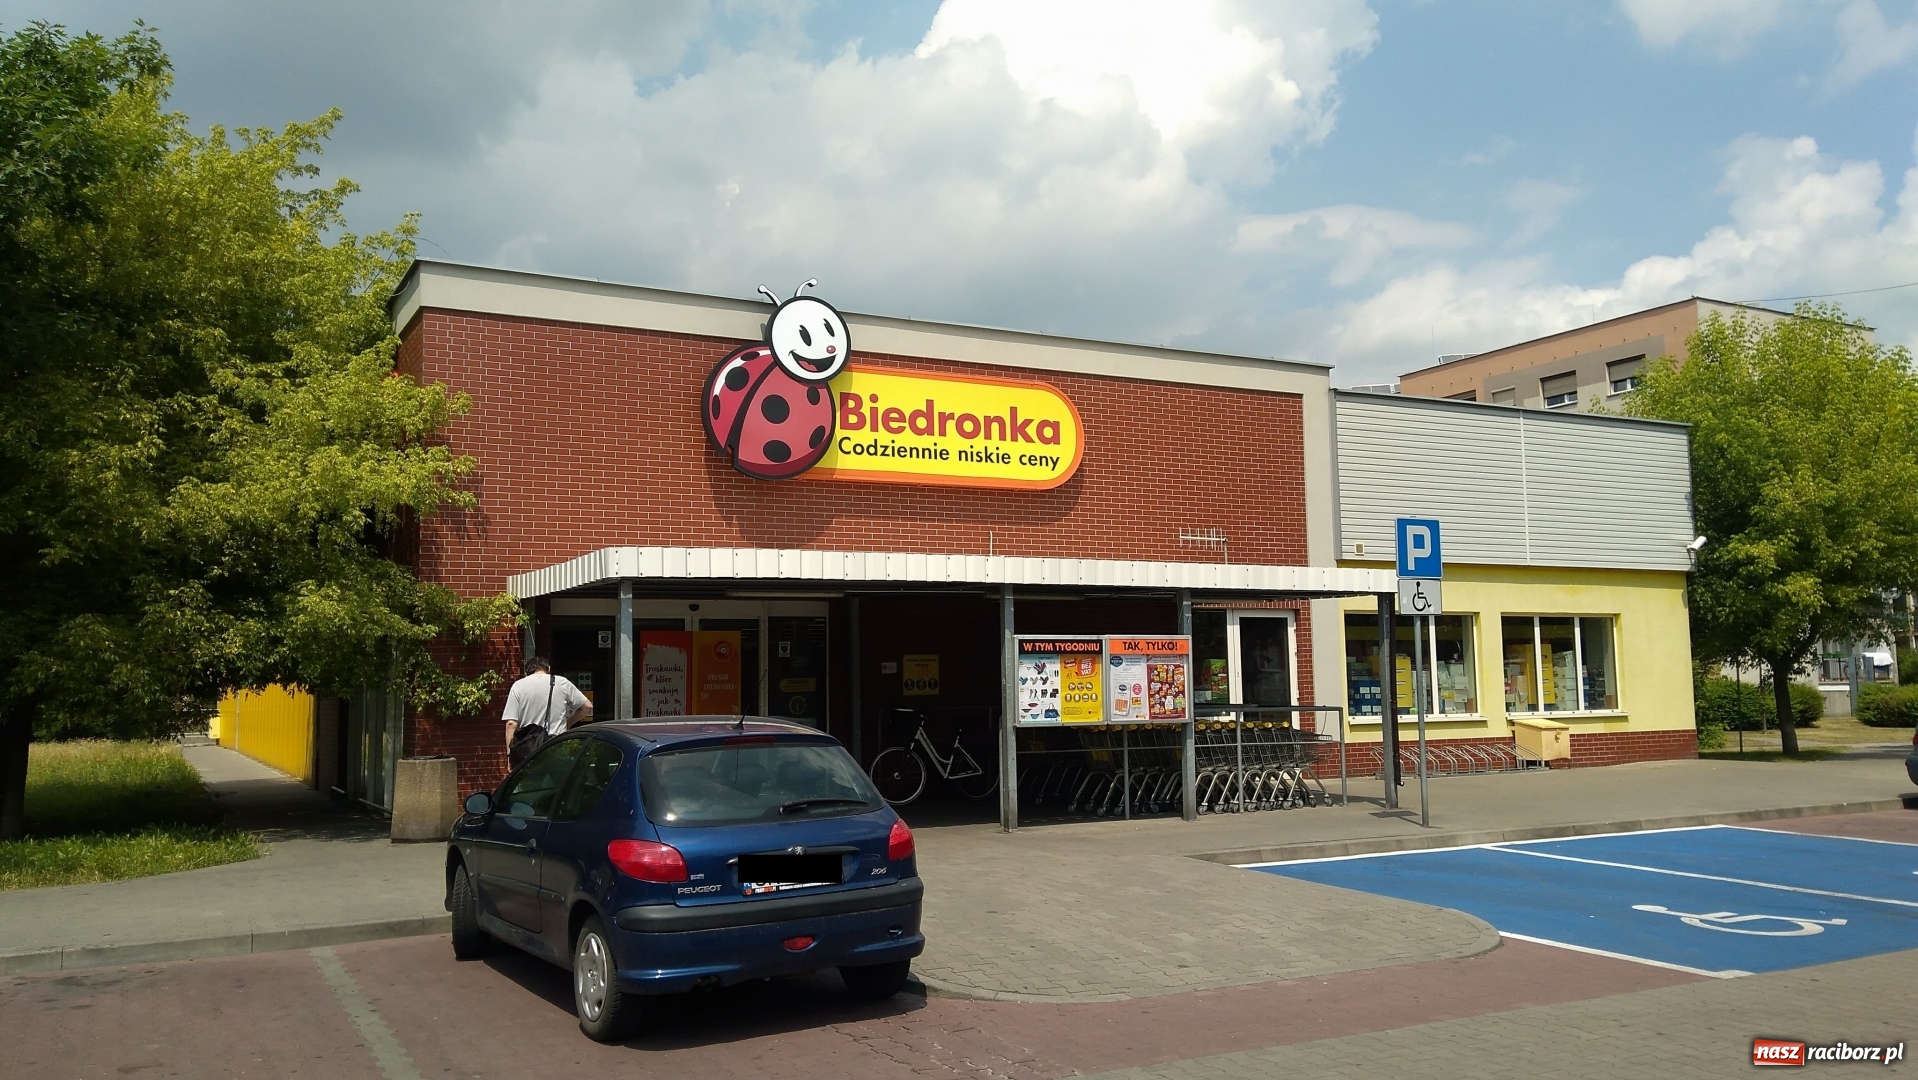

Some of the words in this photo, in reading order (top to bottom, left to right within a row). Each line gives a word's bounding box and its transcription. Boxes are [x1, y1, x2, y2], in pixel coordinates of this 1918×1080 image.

[839, 391, 1061, 446] Biedronka
[838, 436, 950, 461] Codziennie
[958, 444, 1012, 465] niskie
[1019, 453, 1061, 472] ceny
[1406, 524, 1432, 571] P
[1023, 642, 1033, 652] W
[1035, 642, 1053, 651] TYM
[1055, 642, 1100, 652] TYGODNIU
[1122, 641, 1143, 652] TAK,
[1145, 641, 1178, 651] TYLKO!
[1081, 662, 1093, 670] BEZ
[1081, 668, 1092, 676] VAT
[655, 675, 672, 684] które
[648, 686, 679, 697] smakują
[657, 697, 670, 708] jak
[871, 867, 887, 876] 206
[677, 884, 722, 895] PEUGEOT
